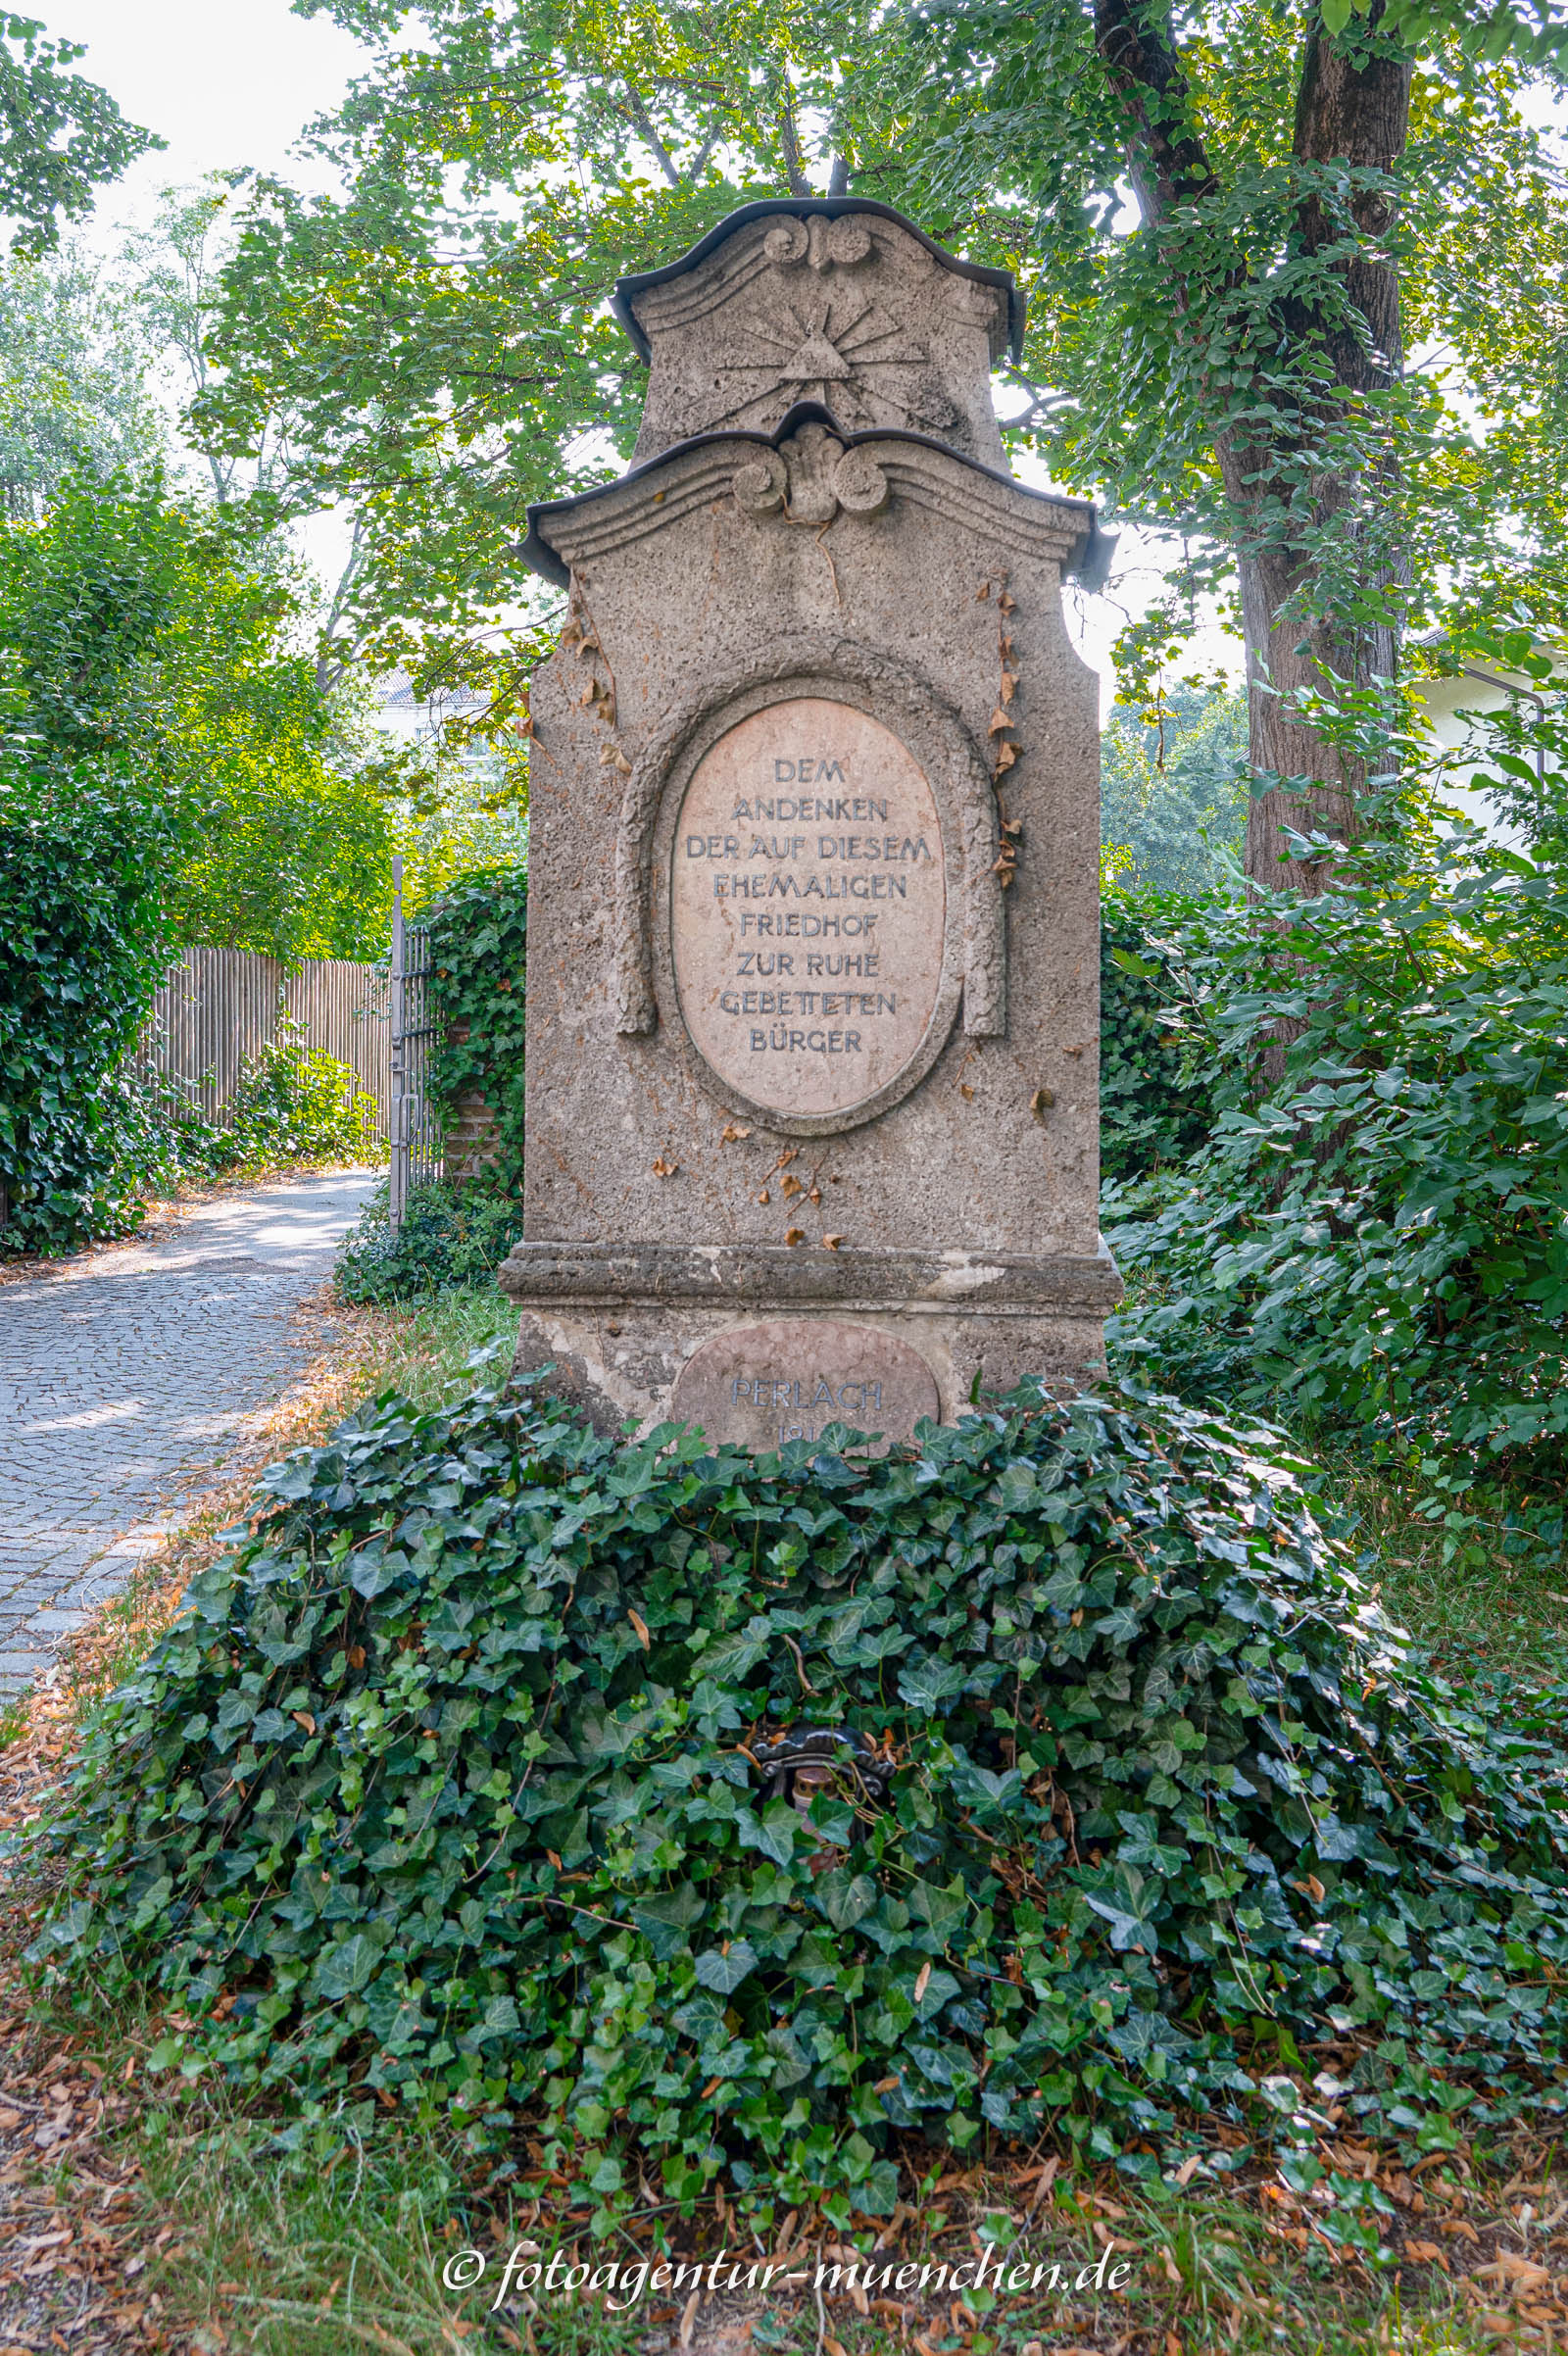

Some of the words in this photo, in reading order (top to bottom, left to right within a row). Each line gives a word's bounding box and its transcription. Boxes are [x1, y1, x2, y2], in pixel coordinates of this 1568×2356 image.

[774, 759, 846, 783] DEM
[731, 798, 887, 821] ANDENKEN
[687, 836, 739, 859] DER
[749, 837, 805, 859] AUF
[817, 837, 931, 859] DIESEM
[713, 874, 906, 899] EHEMALIGEN
[740, 913, 878, 937] FRIEDHOF
[737, 953, 795, 976] ZUR
[807, 954, 879, 977] RUHE
[720, 991, 896, 1015] GEBETTETEN
[750, 1022, 861, 1053] BÜRGER
[731, 1380, 883, 1410] PERLACH
